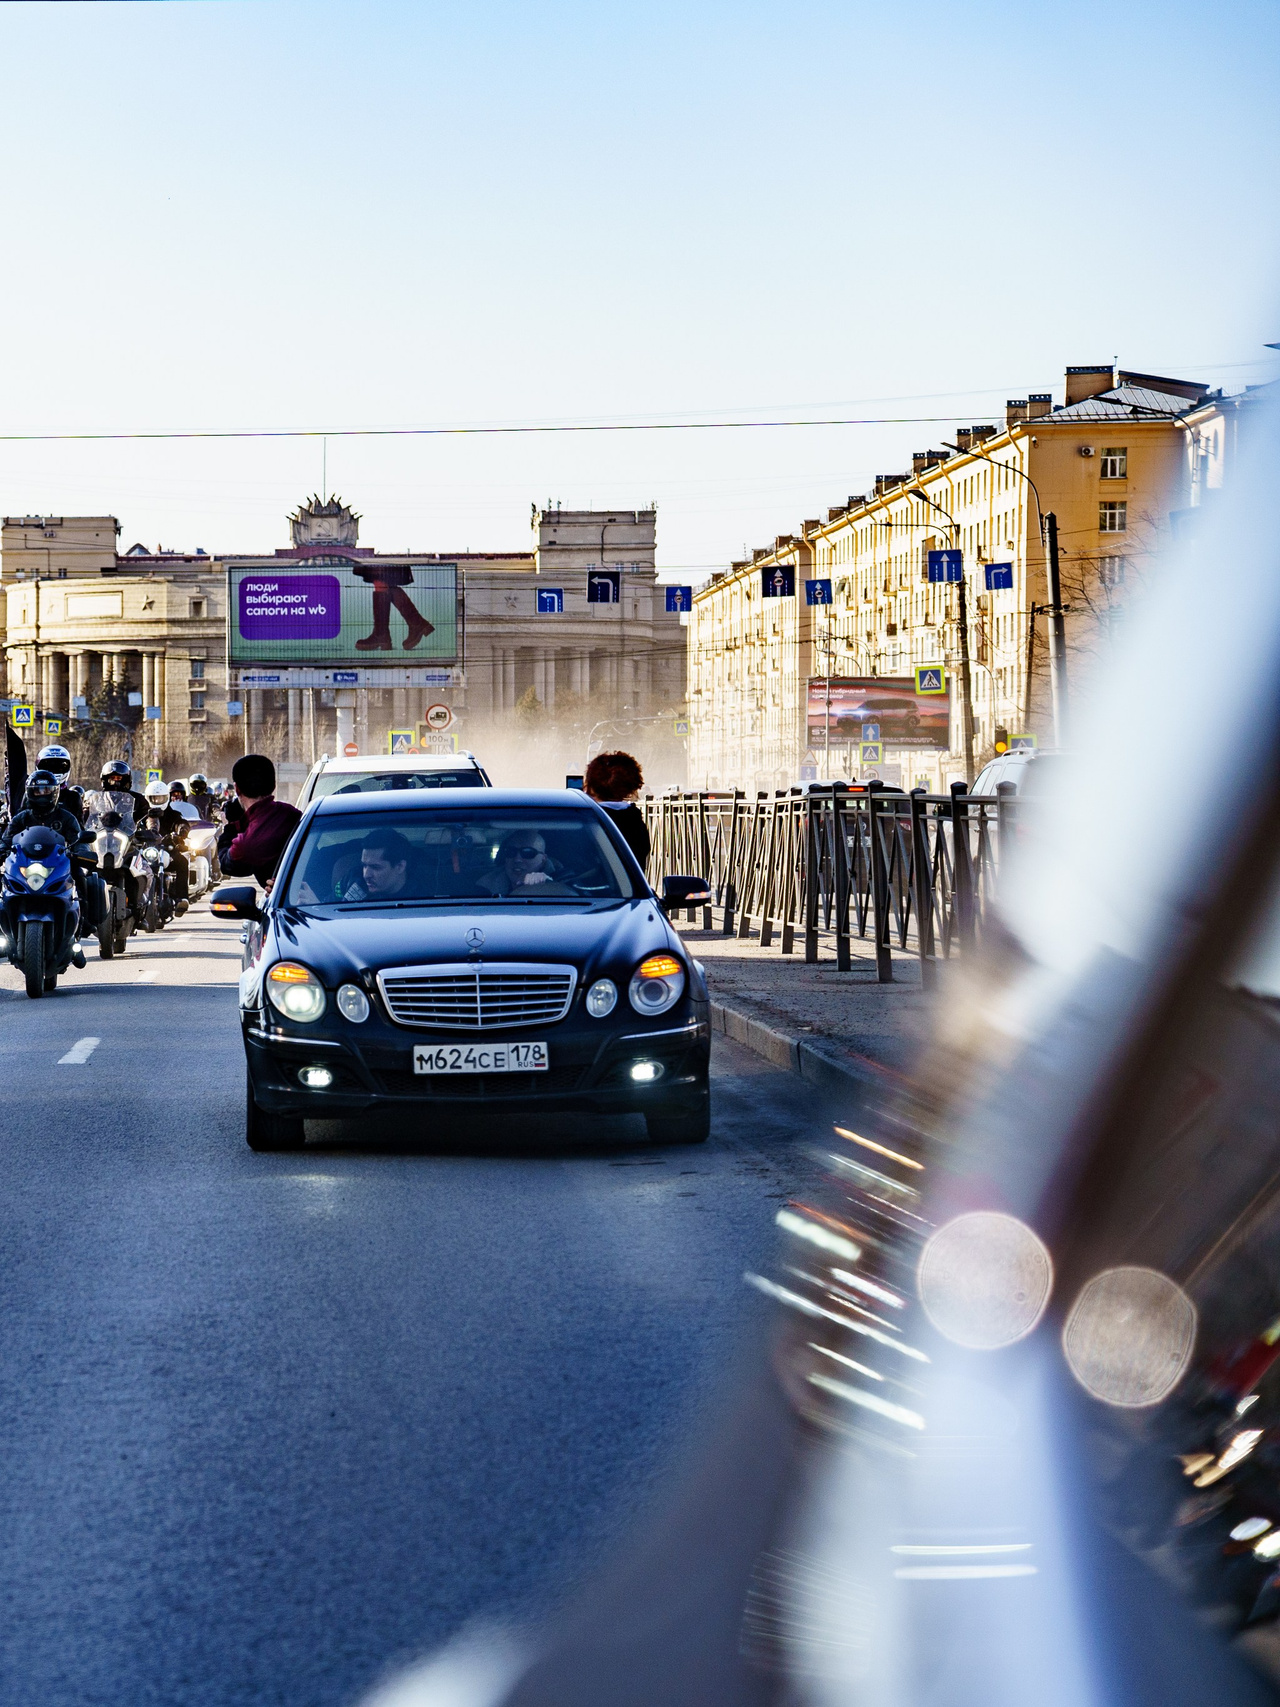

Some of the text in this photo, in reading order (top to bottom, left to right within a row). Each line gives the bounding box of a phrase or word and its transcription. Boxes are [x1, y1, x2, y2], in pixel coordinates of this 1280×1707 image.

[246, 583, 278, 592] люди
[246, 593, 308, 605] выбирают
[246, 603, 326, 616] сапоги на wb
[428, 735, 443, 743] 100
[510, 1045, 542, 1062] 178
